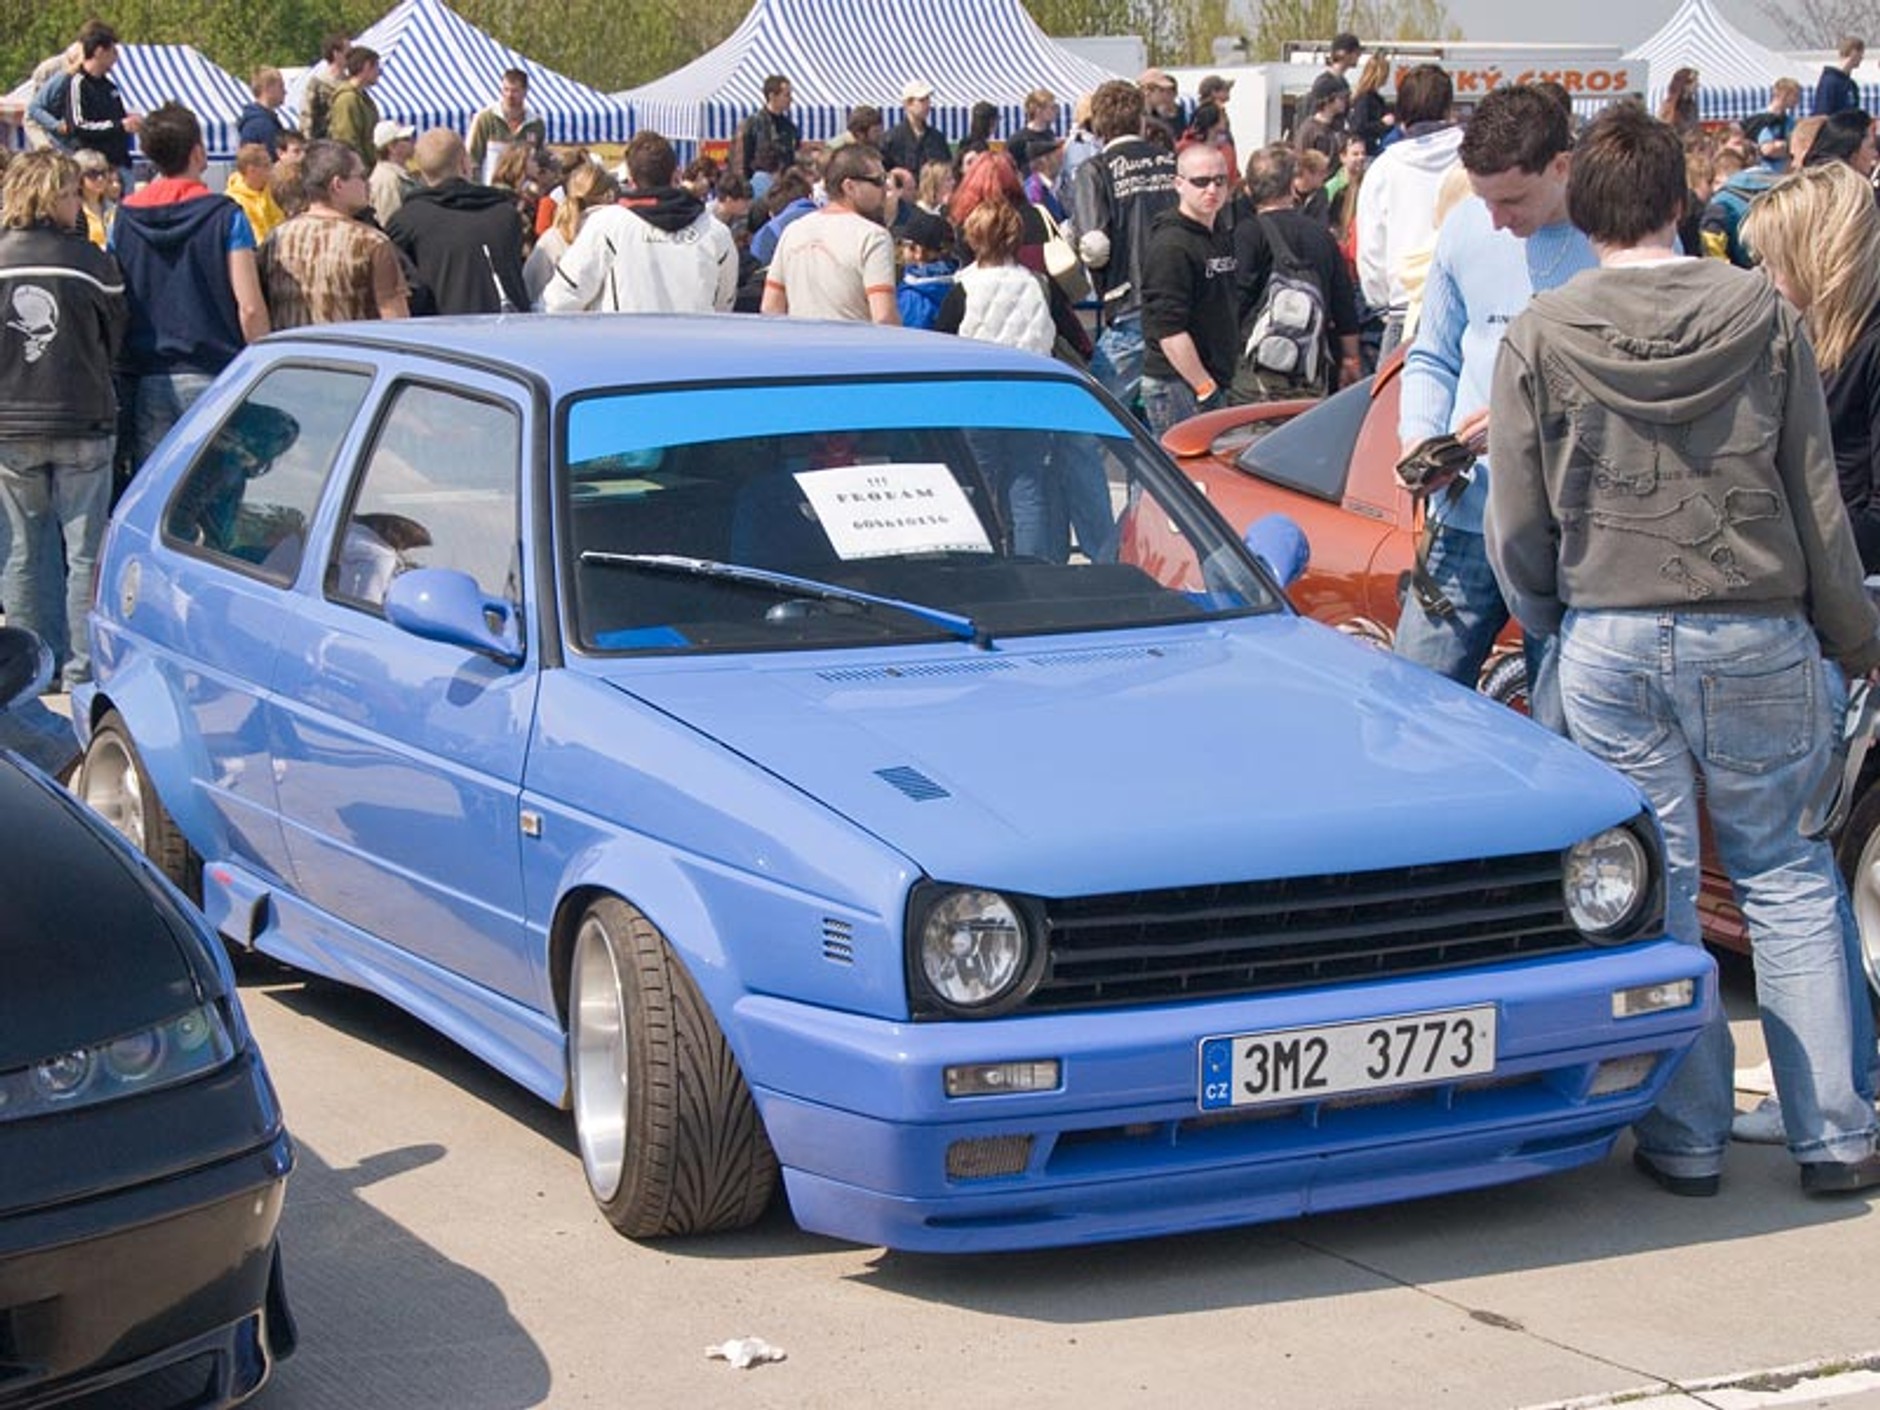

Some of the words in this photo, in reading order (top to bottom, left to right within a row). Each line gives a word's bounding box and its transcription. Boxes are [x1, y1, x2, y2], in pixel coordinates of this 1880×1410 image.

[1243, 1036, 1329, 1094] 3M2
[1366, 1018, 1475, 1080] 3773
[1205, 1082, 1229, 1100] CZ
